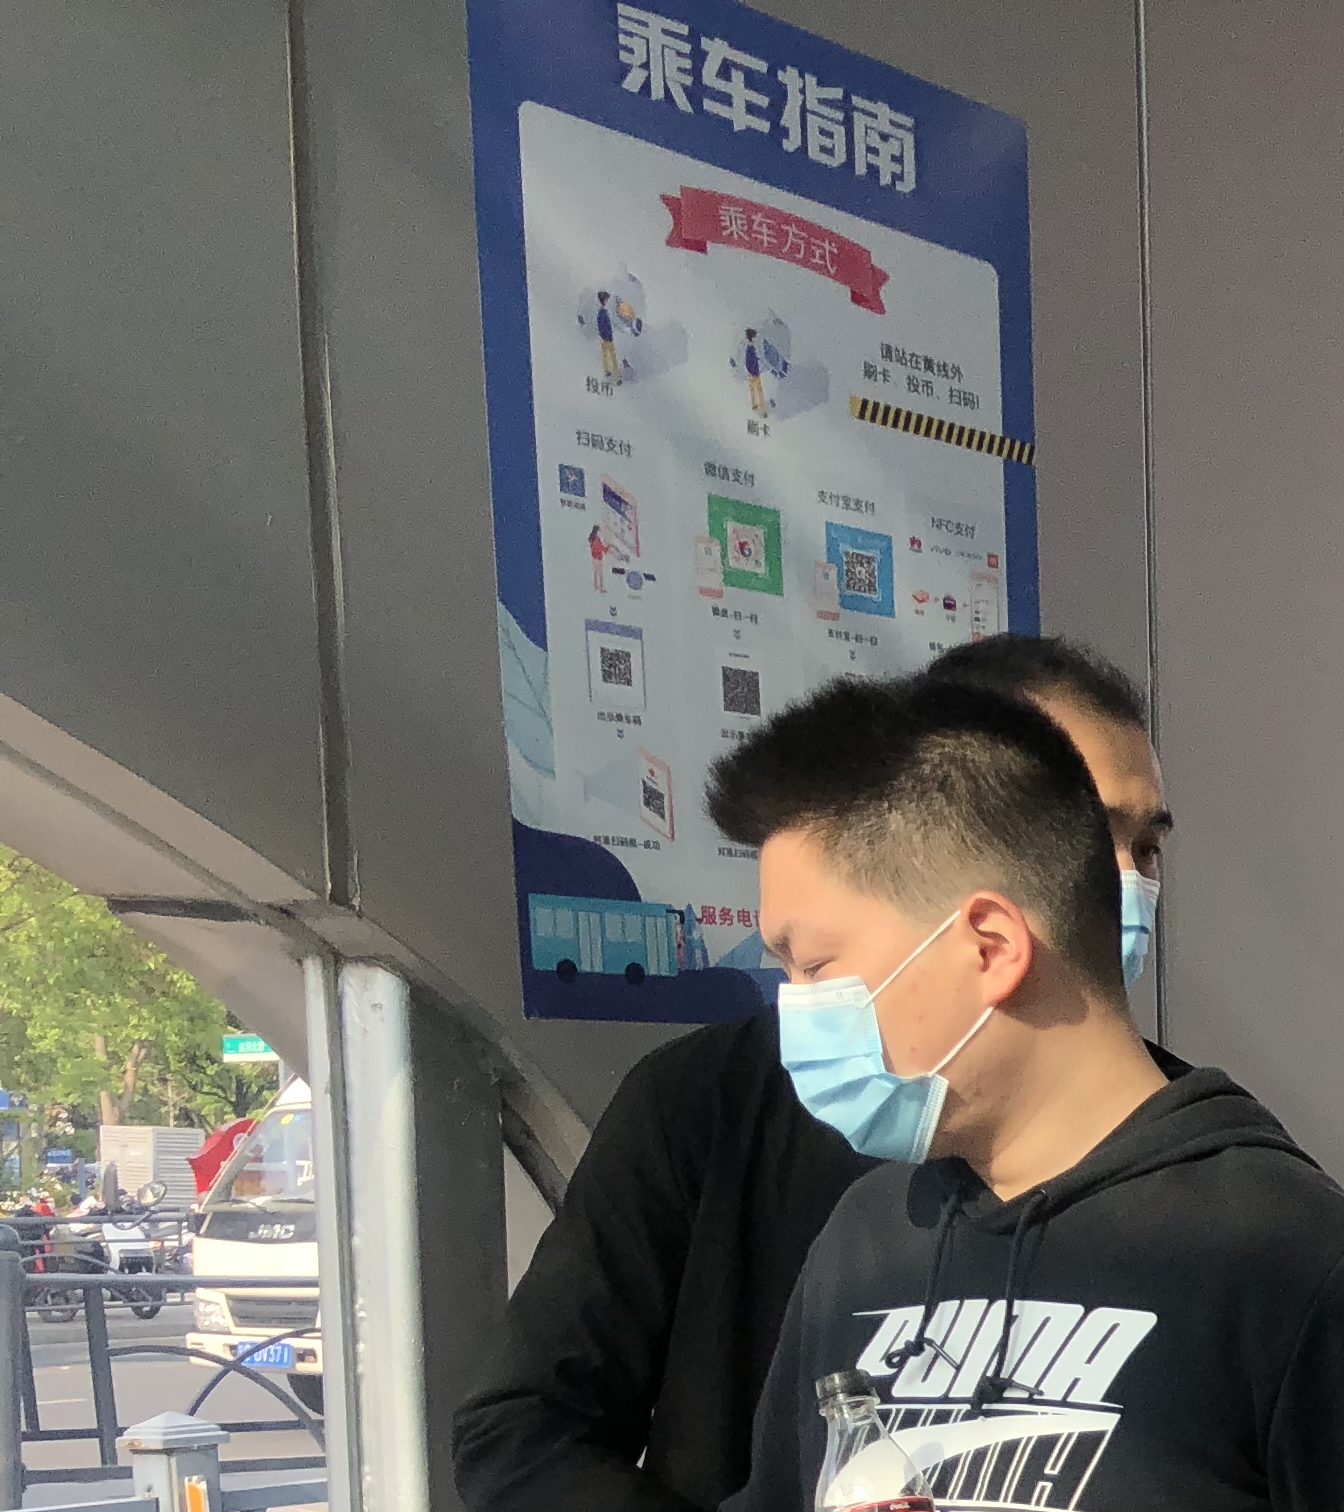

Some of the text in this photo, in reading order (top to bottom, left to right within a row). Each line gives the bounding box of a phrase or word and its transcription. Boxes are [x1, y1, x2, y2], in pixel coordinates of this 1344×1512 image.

[617, 2, 917, 194] 乘车指南
[719, 204, 839, 275] 乘车方式
